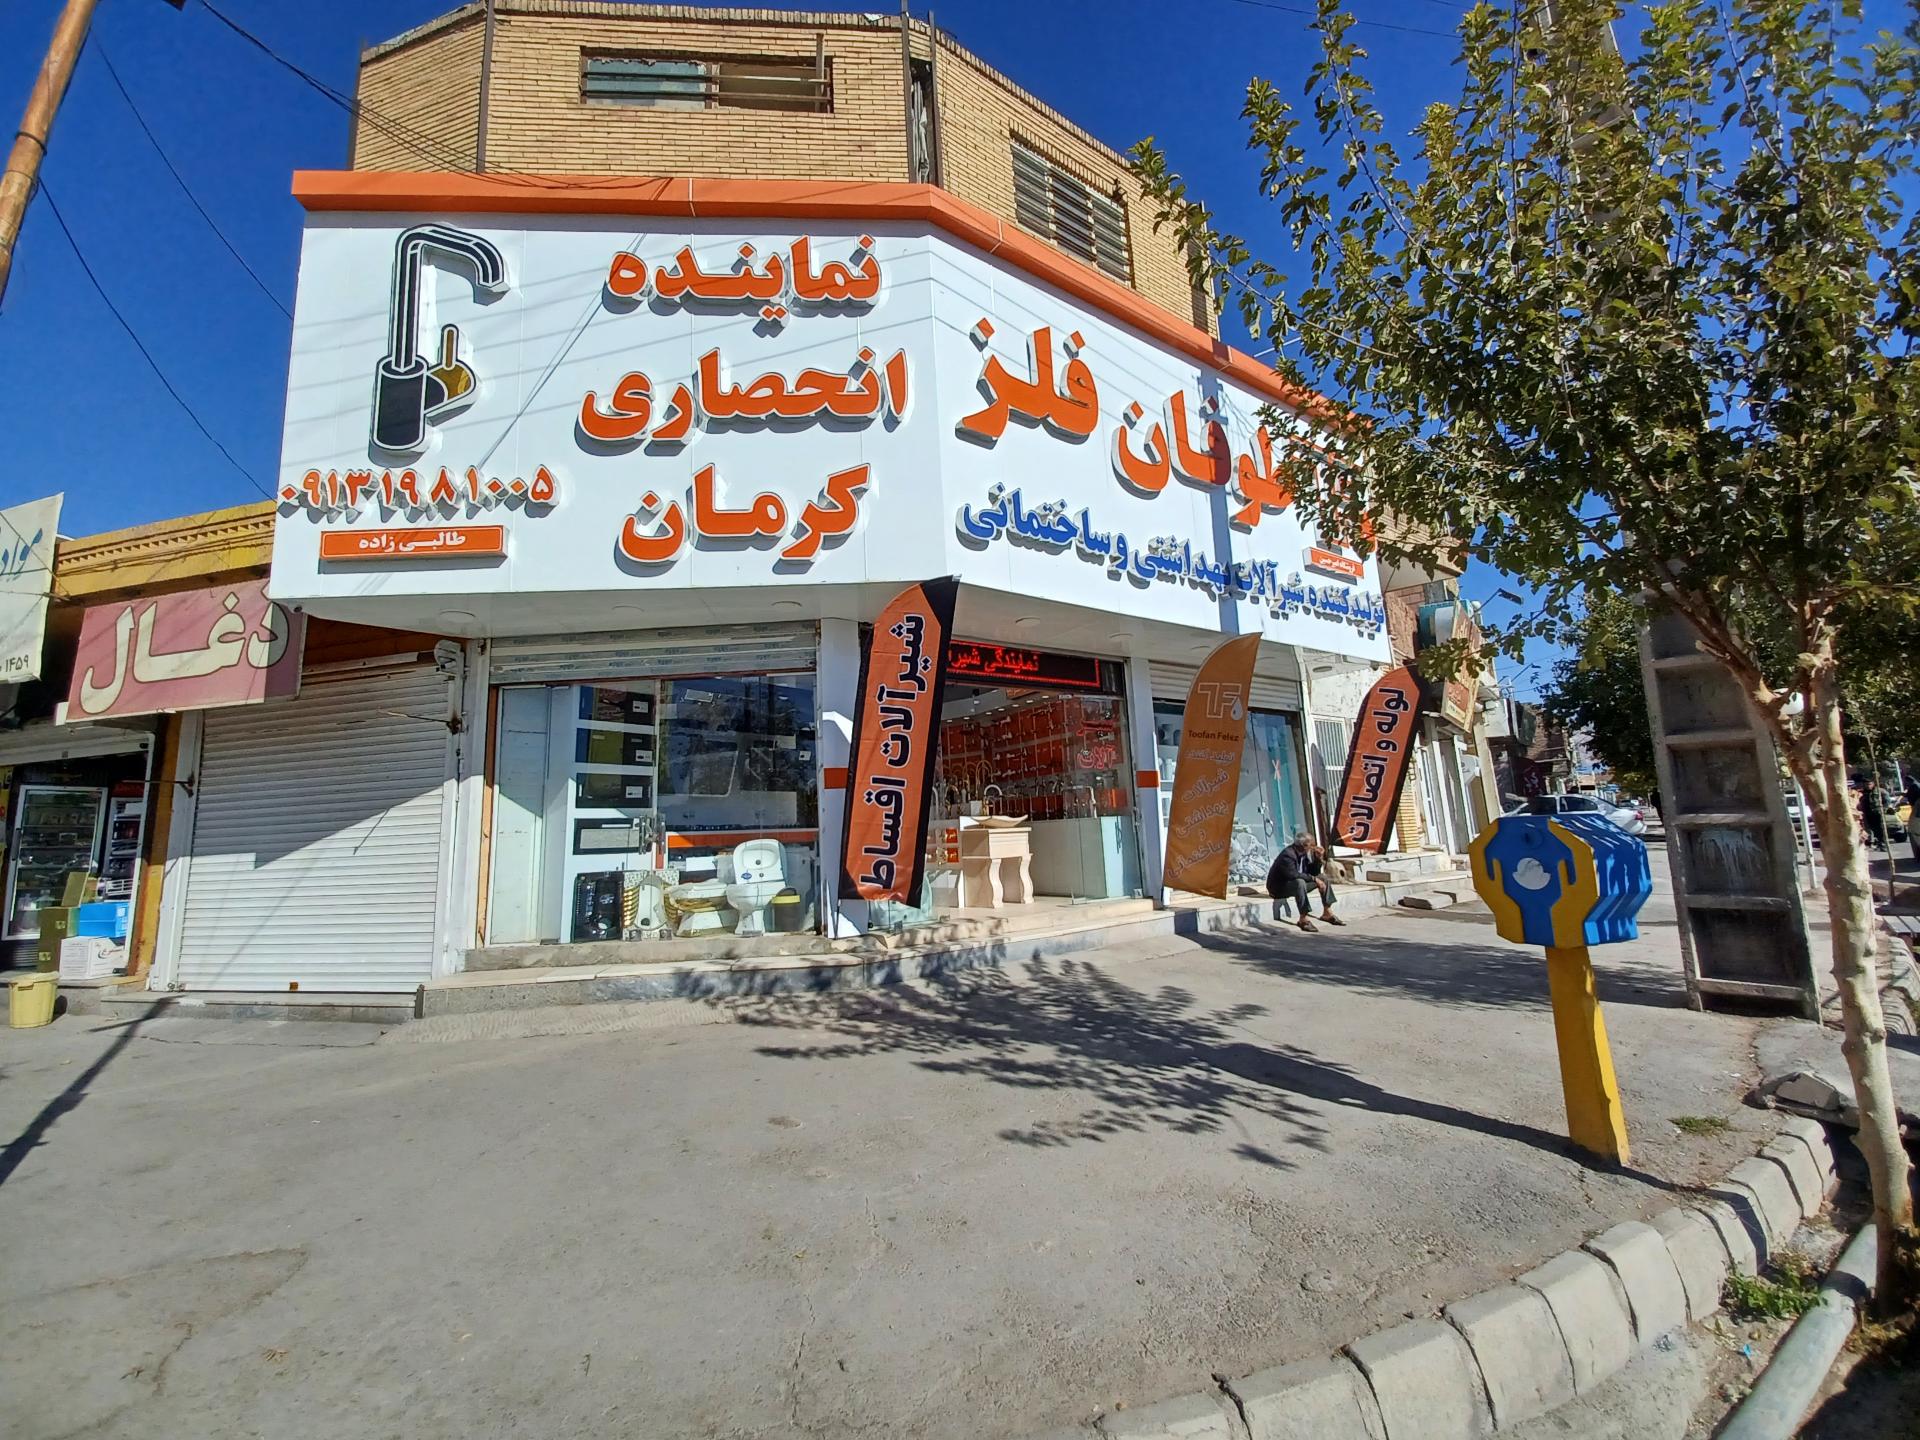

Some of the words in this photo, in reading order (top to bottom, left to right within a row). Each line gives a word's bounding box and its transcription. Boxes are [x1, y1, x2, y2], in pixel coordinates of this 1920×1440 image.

[607, 234, 882, 323] نماینده
[578, 346, 909, 442] انحصاری
[960, 317, 1100, 438] فلز
[1116, 389, 1298, 525] طوفان
[280, 464, 556, 507] ۰۹۱۳۱۹۸۱۰۰۵
[618, 462, 870, 564] کرمان
[358, 533, 396, 553] زاده
[399, 530, 466, 552] طالبی
[1134, 536, 1231, 594] بهداشتی
[984, 648, 1039, 674] نمایندگی
[1197, 682, 1242, 719] TF
[1372, 687, 1410, 734] لوله
[1188, 729, 1217, 741] Toofan
[1217, 731, 1239, 742] Felez
[1375, 738, 1398, 753] و
[1347, 754, 1389, 843] اتصالات
[858, 774, 907, 890] اقساط
